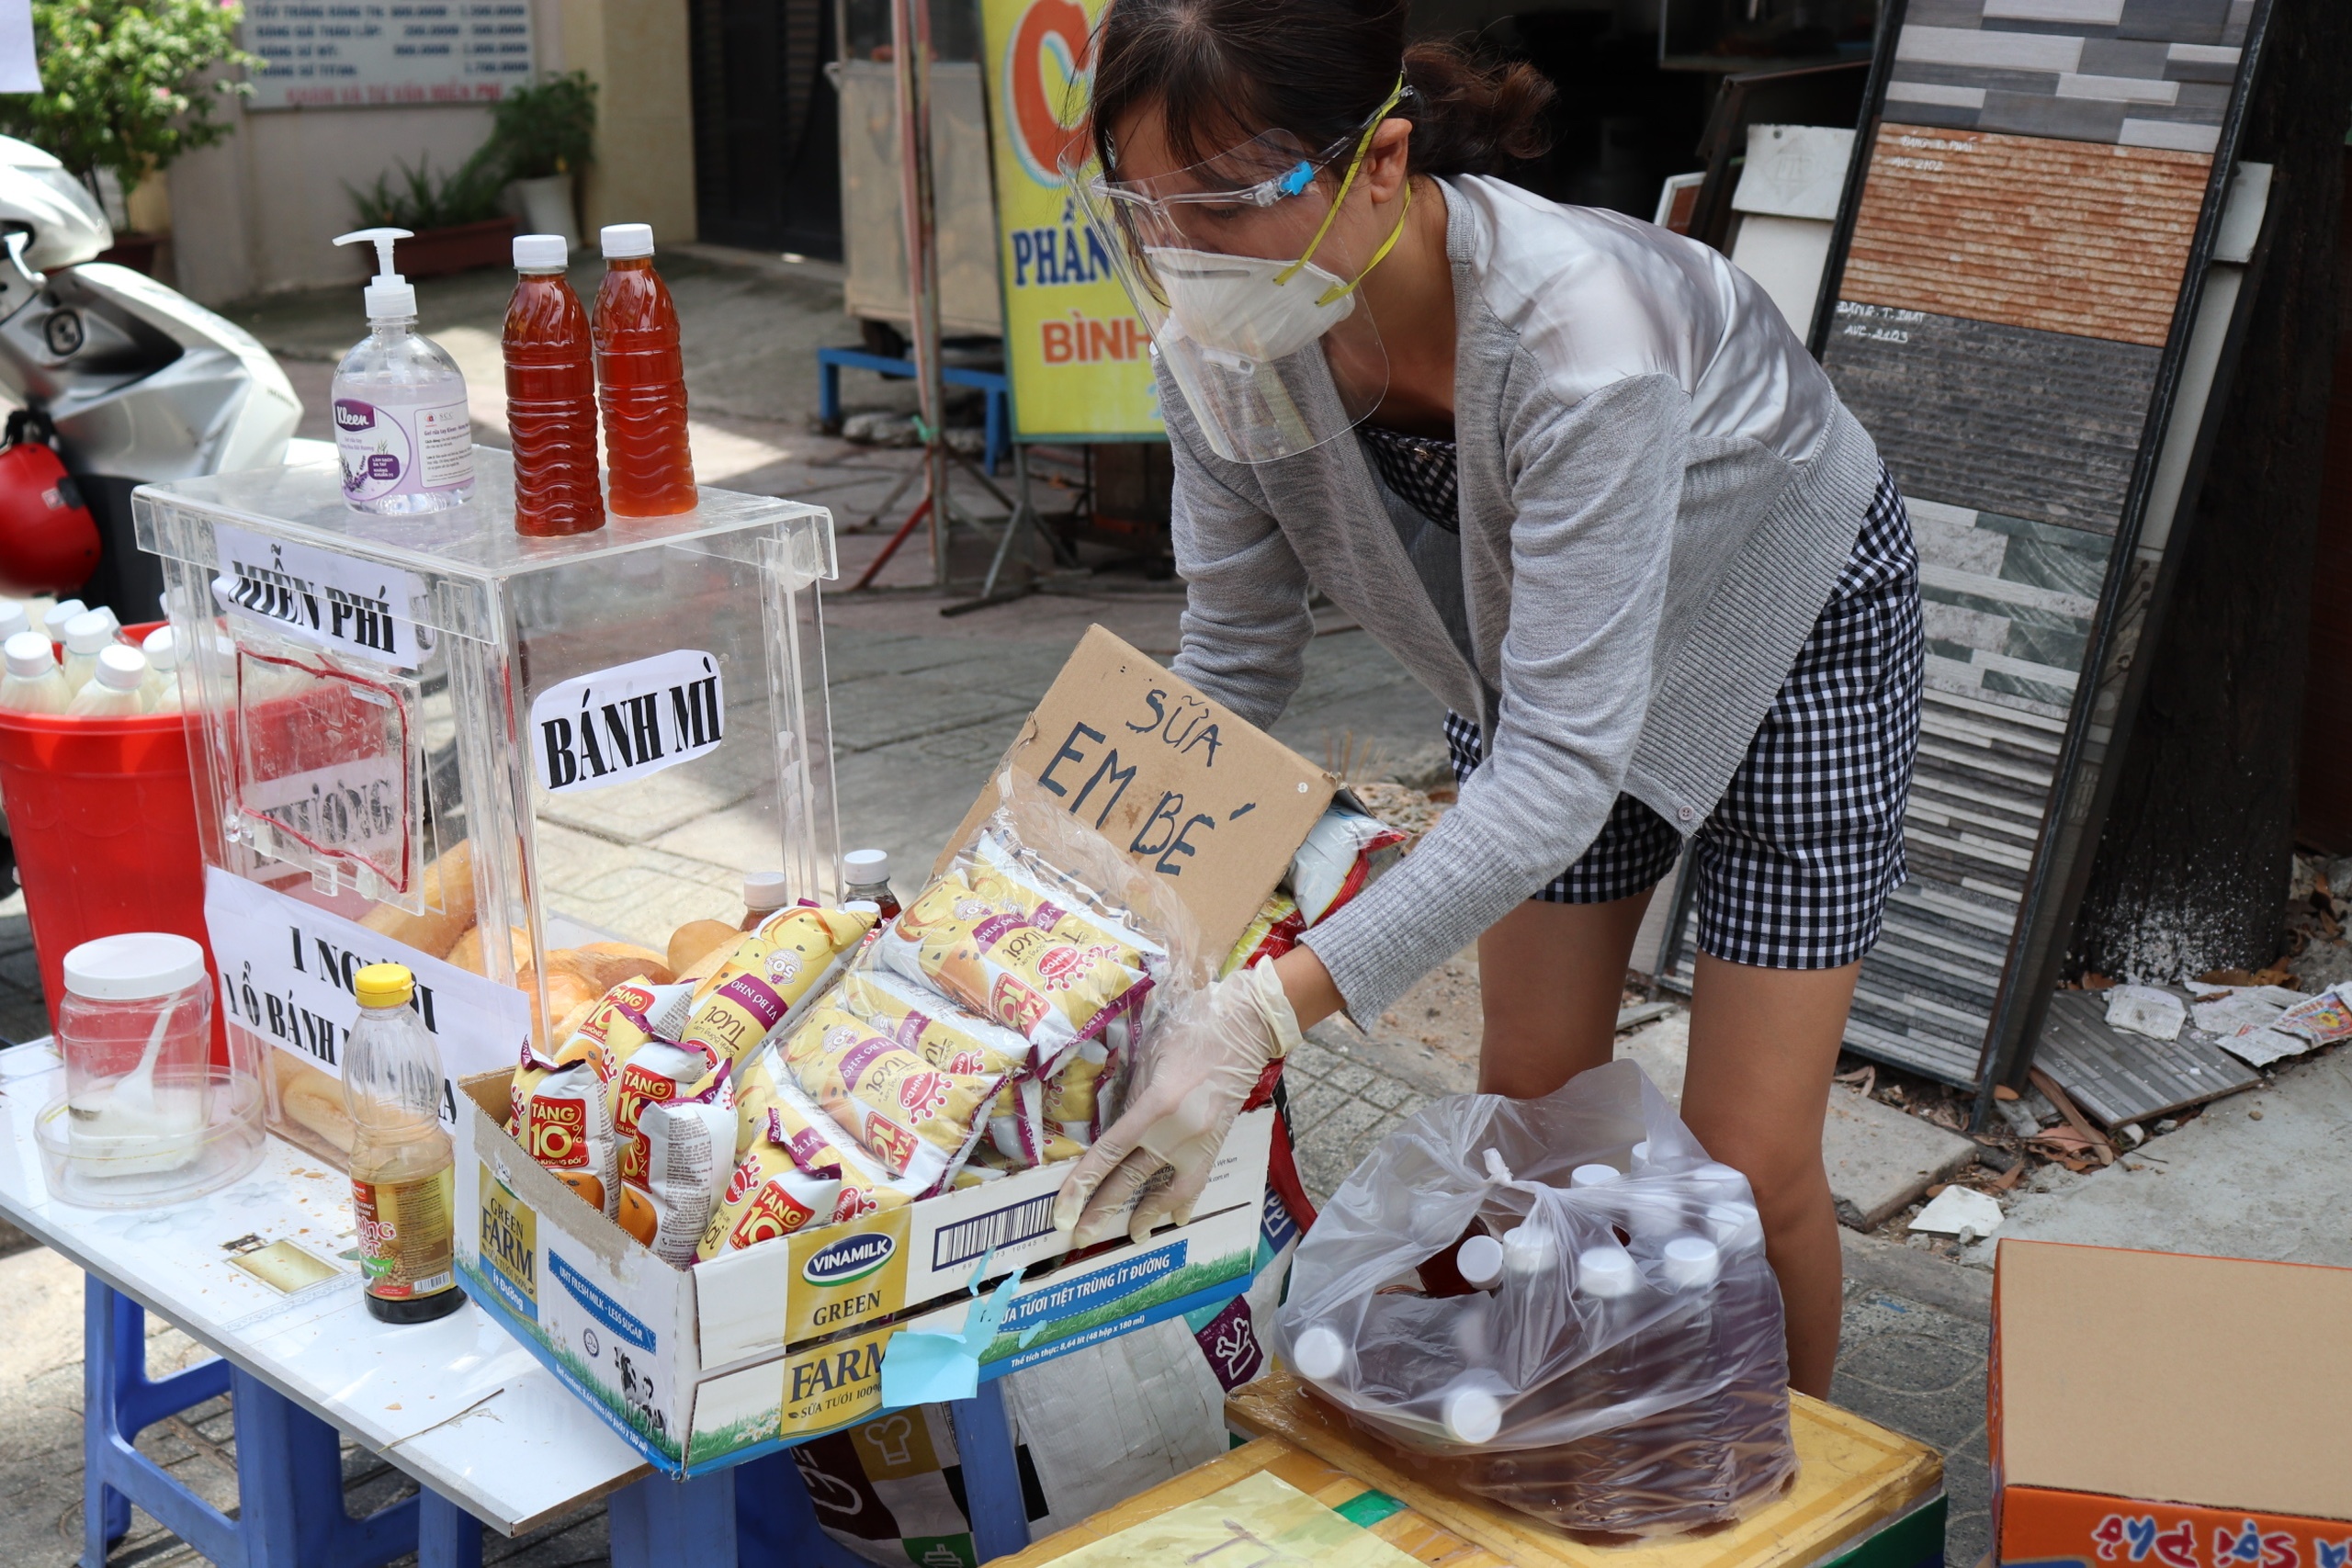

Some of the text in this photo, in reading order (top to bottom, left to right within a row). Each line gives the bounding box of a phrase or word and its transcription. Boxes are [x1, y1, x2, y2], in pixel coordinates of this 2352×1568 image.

[1041, 310, 1152, 364] BÌNH
[336, 406, 369, 425] Kleen
[323, 585, 397, 655] PHÍ
[541, 656, 722, 790] BÁNH MÌ
[1125, 688, 1224, 768] SỮA
[1037, 721, 1137, 831] EM
[1129, 789, 1257, 877] BÉ
[1040, 948, 1076, 975] KINHDO
[729, 980, 755, 998] NHO
[264, 988, 338, 1066] BÁNH
[765, 1004, 778, 1021] VỊ
[1018, 990, 1046, 1031] TĂN
[625, 1069, 667, 1096] TĂNG
[842, 1055, 865, 1078] NHO
[531, 1100, 575, 1122] TĂNG
[888, 1133, 915, 1173] TĂN
[490, 1197, 525, 1240] GREEN
[761, 1186, 804, 1225] TĂNG
[481, 1205, 535, 1285] FARM
[813, 1237, 888, 1274] VINAMILK
[1012, 1240, 1038, 1254] 10045
[500, 1279, 524, 1312] Đường
[560, 1265, 644, 1342] UHT FRESH MILK LESS SUGAR
[1020, 1253, 1170, 1317] TƯƠI TIỆT TRÙNG ÍT ĐƯỜNG
[813, 1290, 882, 1326] GREEN
[1025, 1350, 1040, 1364] tích
[1040, 1345, 1059, 1358] thực:
[1059, 1339, 1077, 1350] 8,64
[1076, 1336, 1086, 1346] lít
[1085, 1329, 1098, 1343] (48
[1098, 1326, 1114, 1339] hộp
[1119, 1320, 1133, 1329] 180
[1132, 1314, 1146, 1325] ml)
[800, 1402, 822, 1419] SỮA
[855, 1384, 882, 1399] 100%
[613, 1417, 627, 1435] packs
[629, 1431, 639, 1446] 180
